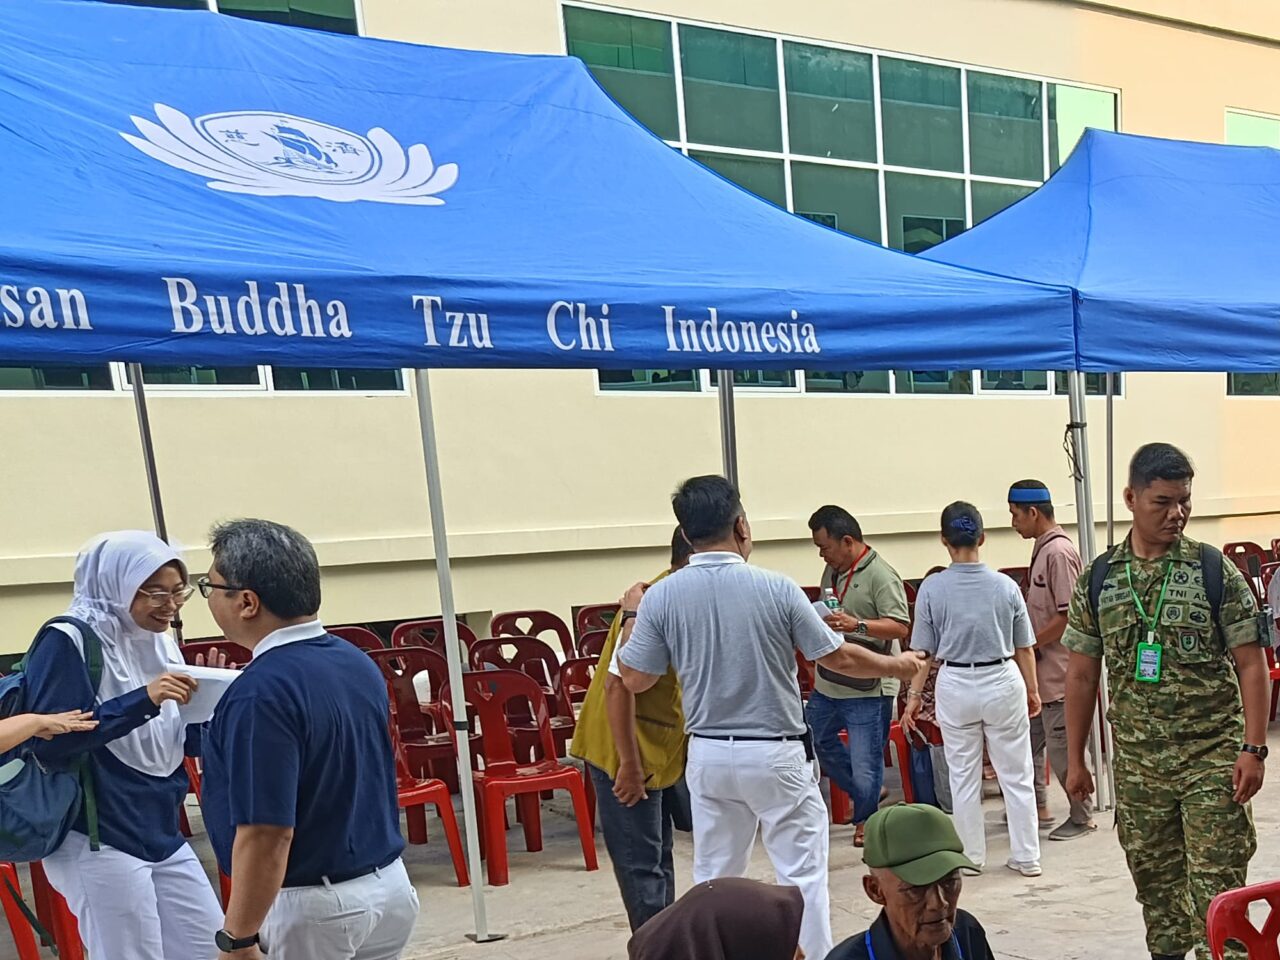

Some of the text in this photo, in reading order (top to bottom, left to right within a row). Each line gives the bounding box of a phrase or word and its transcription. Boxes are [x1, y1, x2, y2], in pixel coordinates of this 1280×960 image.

[0, 277, 822, 354] san Buddha Tzu Chi Indonesia
[1169, 589, 1187, 598] TNI
